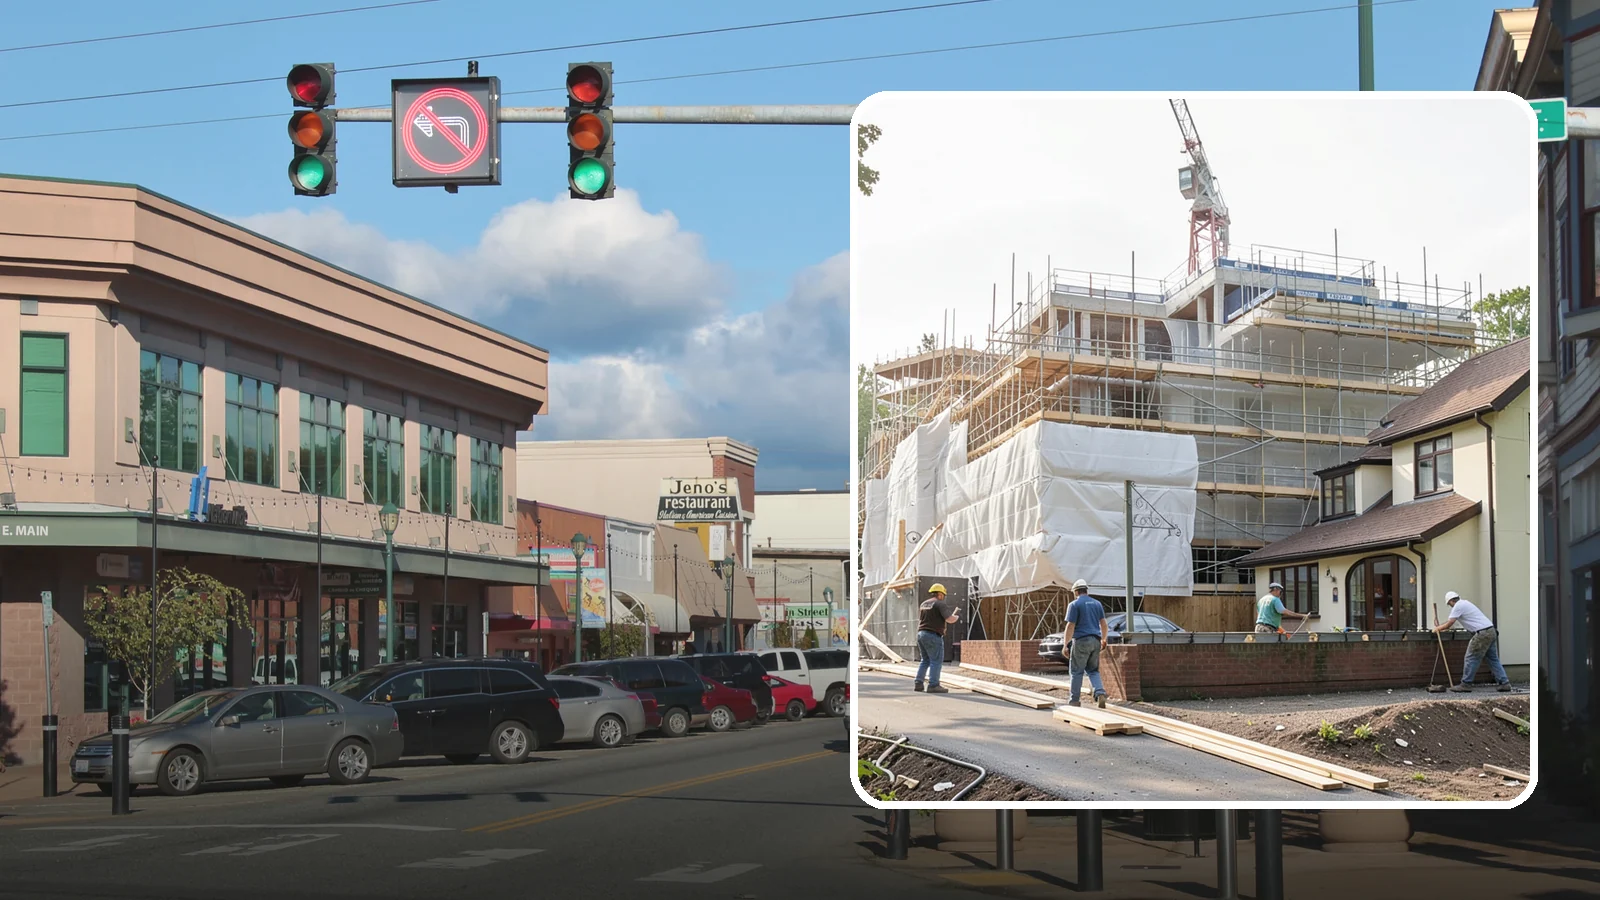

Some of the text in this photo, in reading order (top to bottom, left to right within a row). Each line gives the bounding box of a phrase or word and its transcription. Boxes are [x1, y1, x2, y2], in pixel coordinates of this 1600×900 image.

[670, 480, 727, 494] Jeno's
[665, 496, 731, 508] restaurant
[659, 510, 681, 519] Italian
[686, 510, 714, 519] American
[715, 510, 737, 519] Cuisine
[2, 525, 49, 536] E. MAIN
[797, 607, 828, 617] Street
